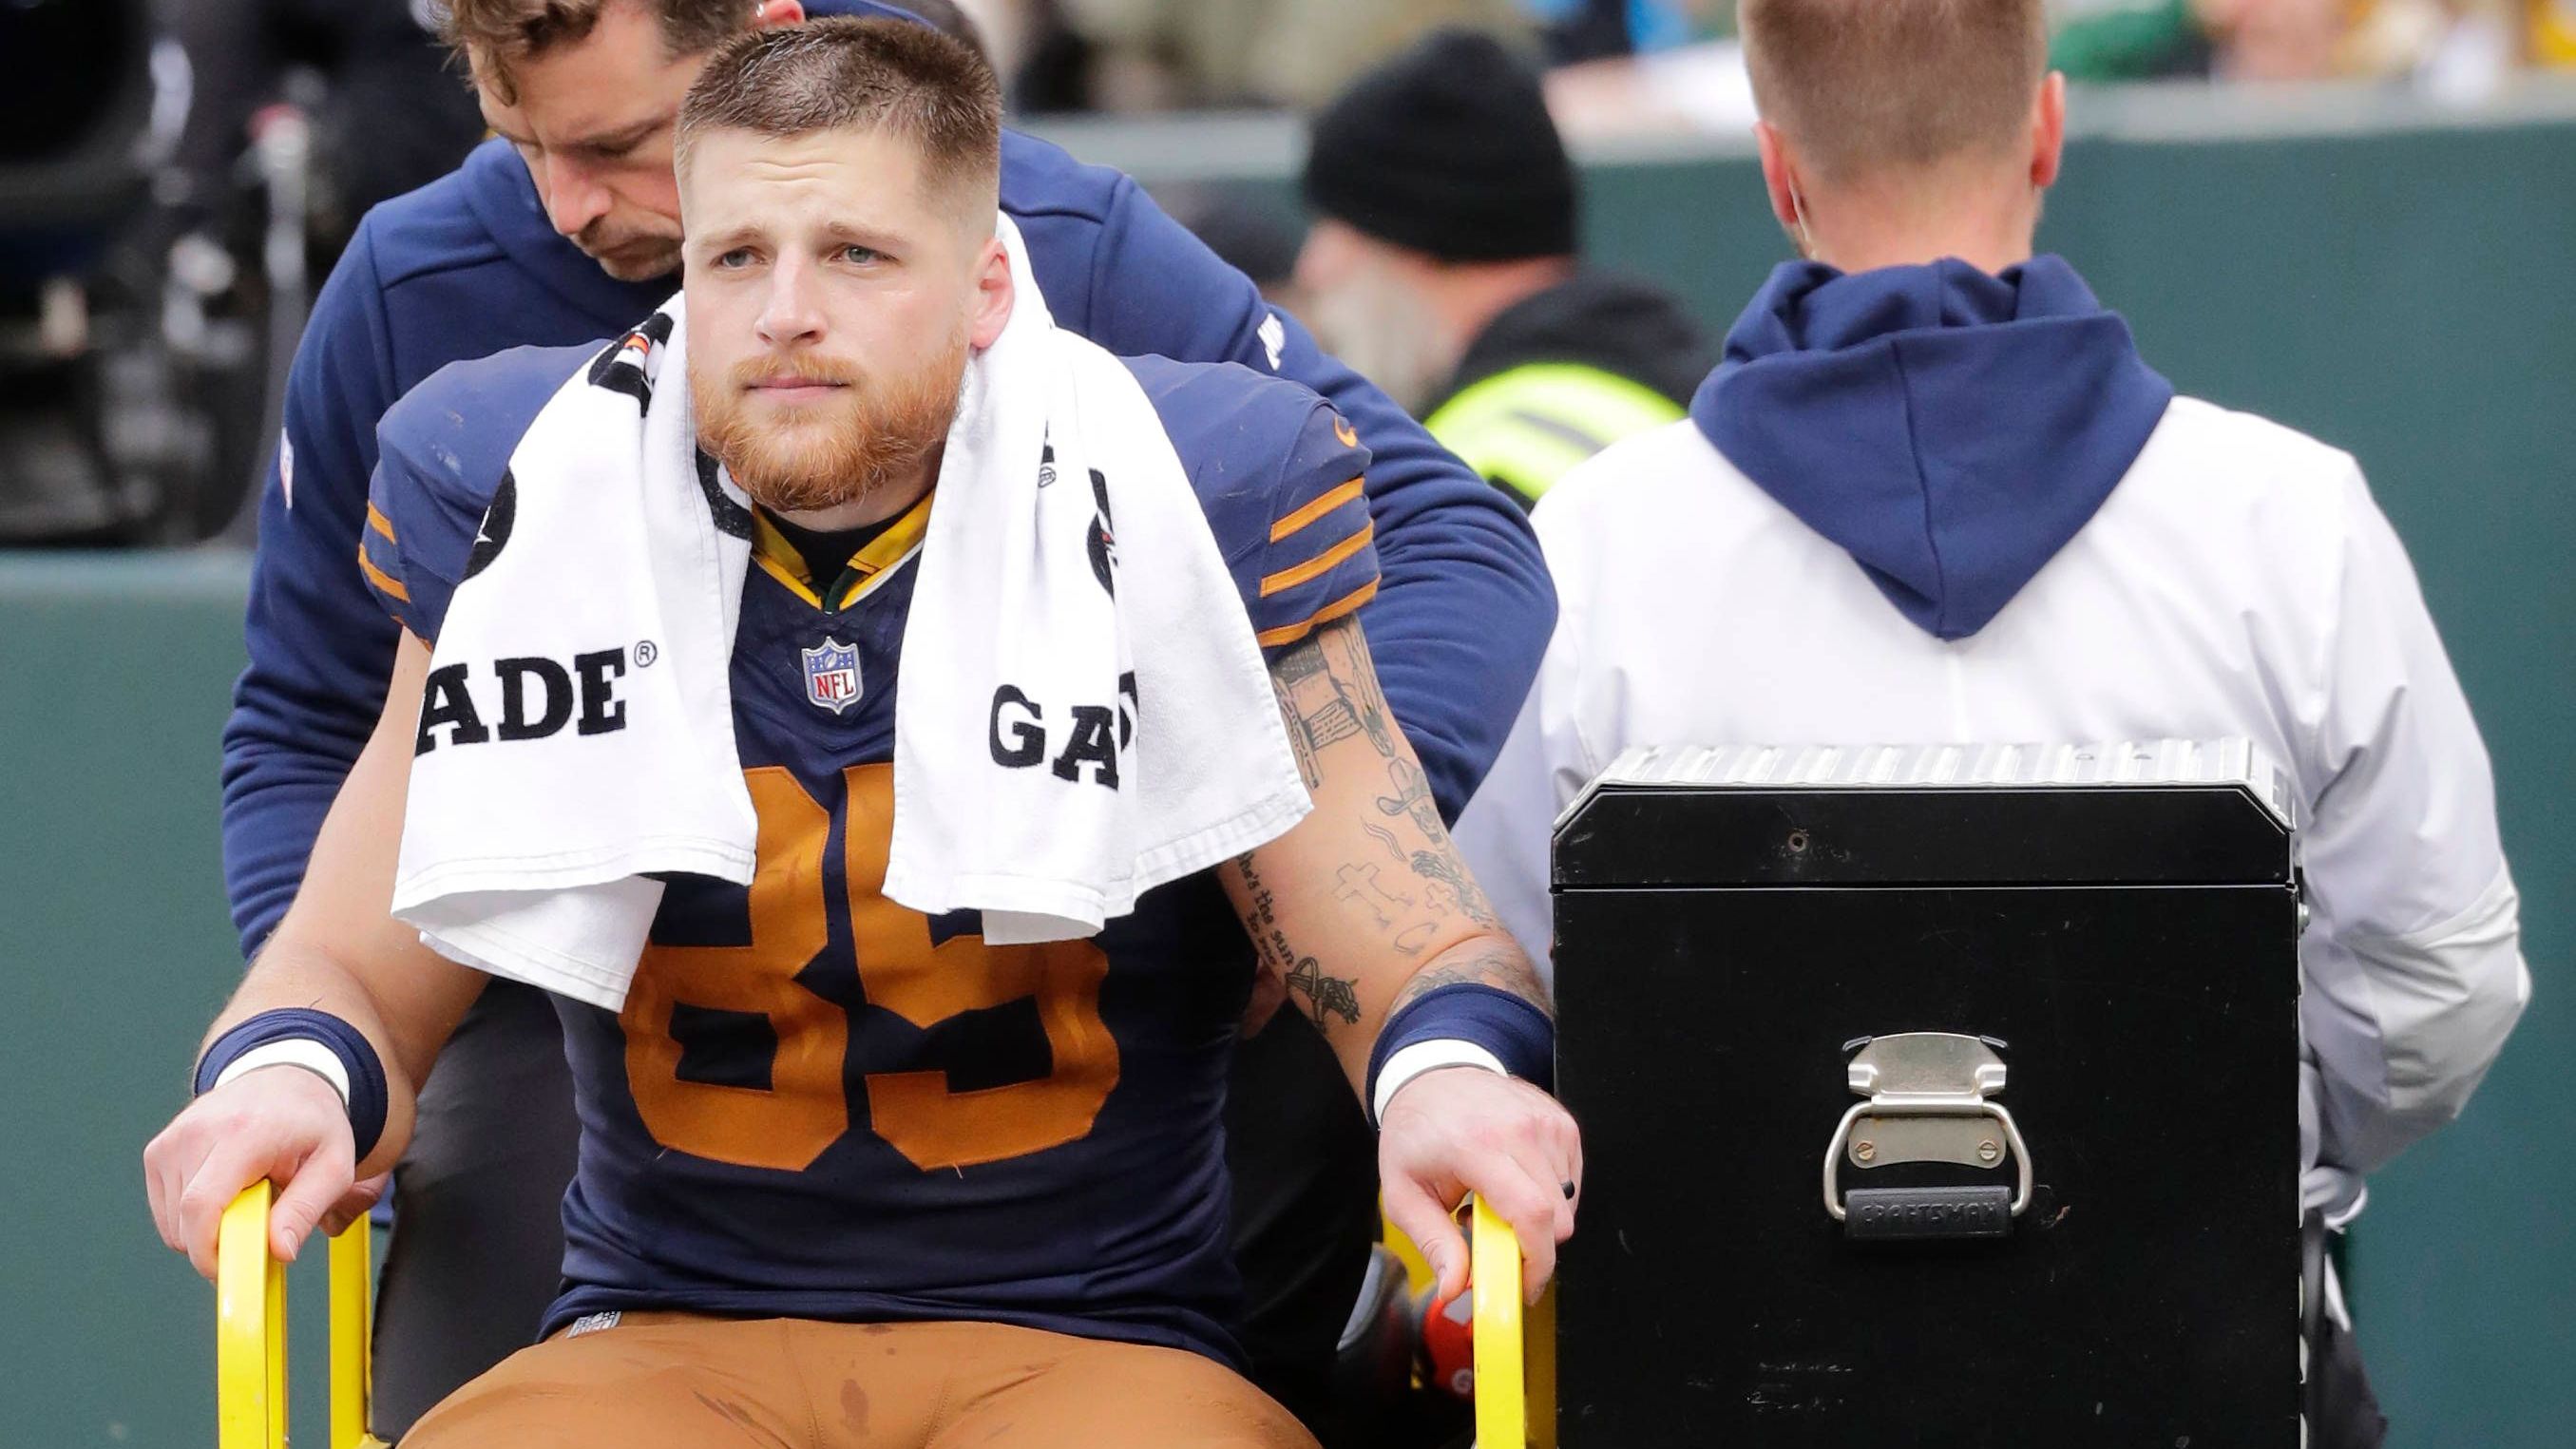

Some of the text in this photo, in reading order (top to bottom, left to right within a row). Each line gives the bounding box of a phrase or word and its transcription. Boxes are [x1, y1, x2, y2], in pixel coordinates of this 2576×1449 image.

[814, 672, 854, 700] NFL
[617, 760, 1121, 1173] 85
[1270, 929, 1296, 967] sun
